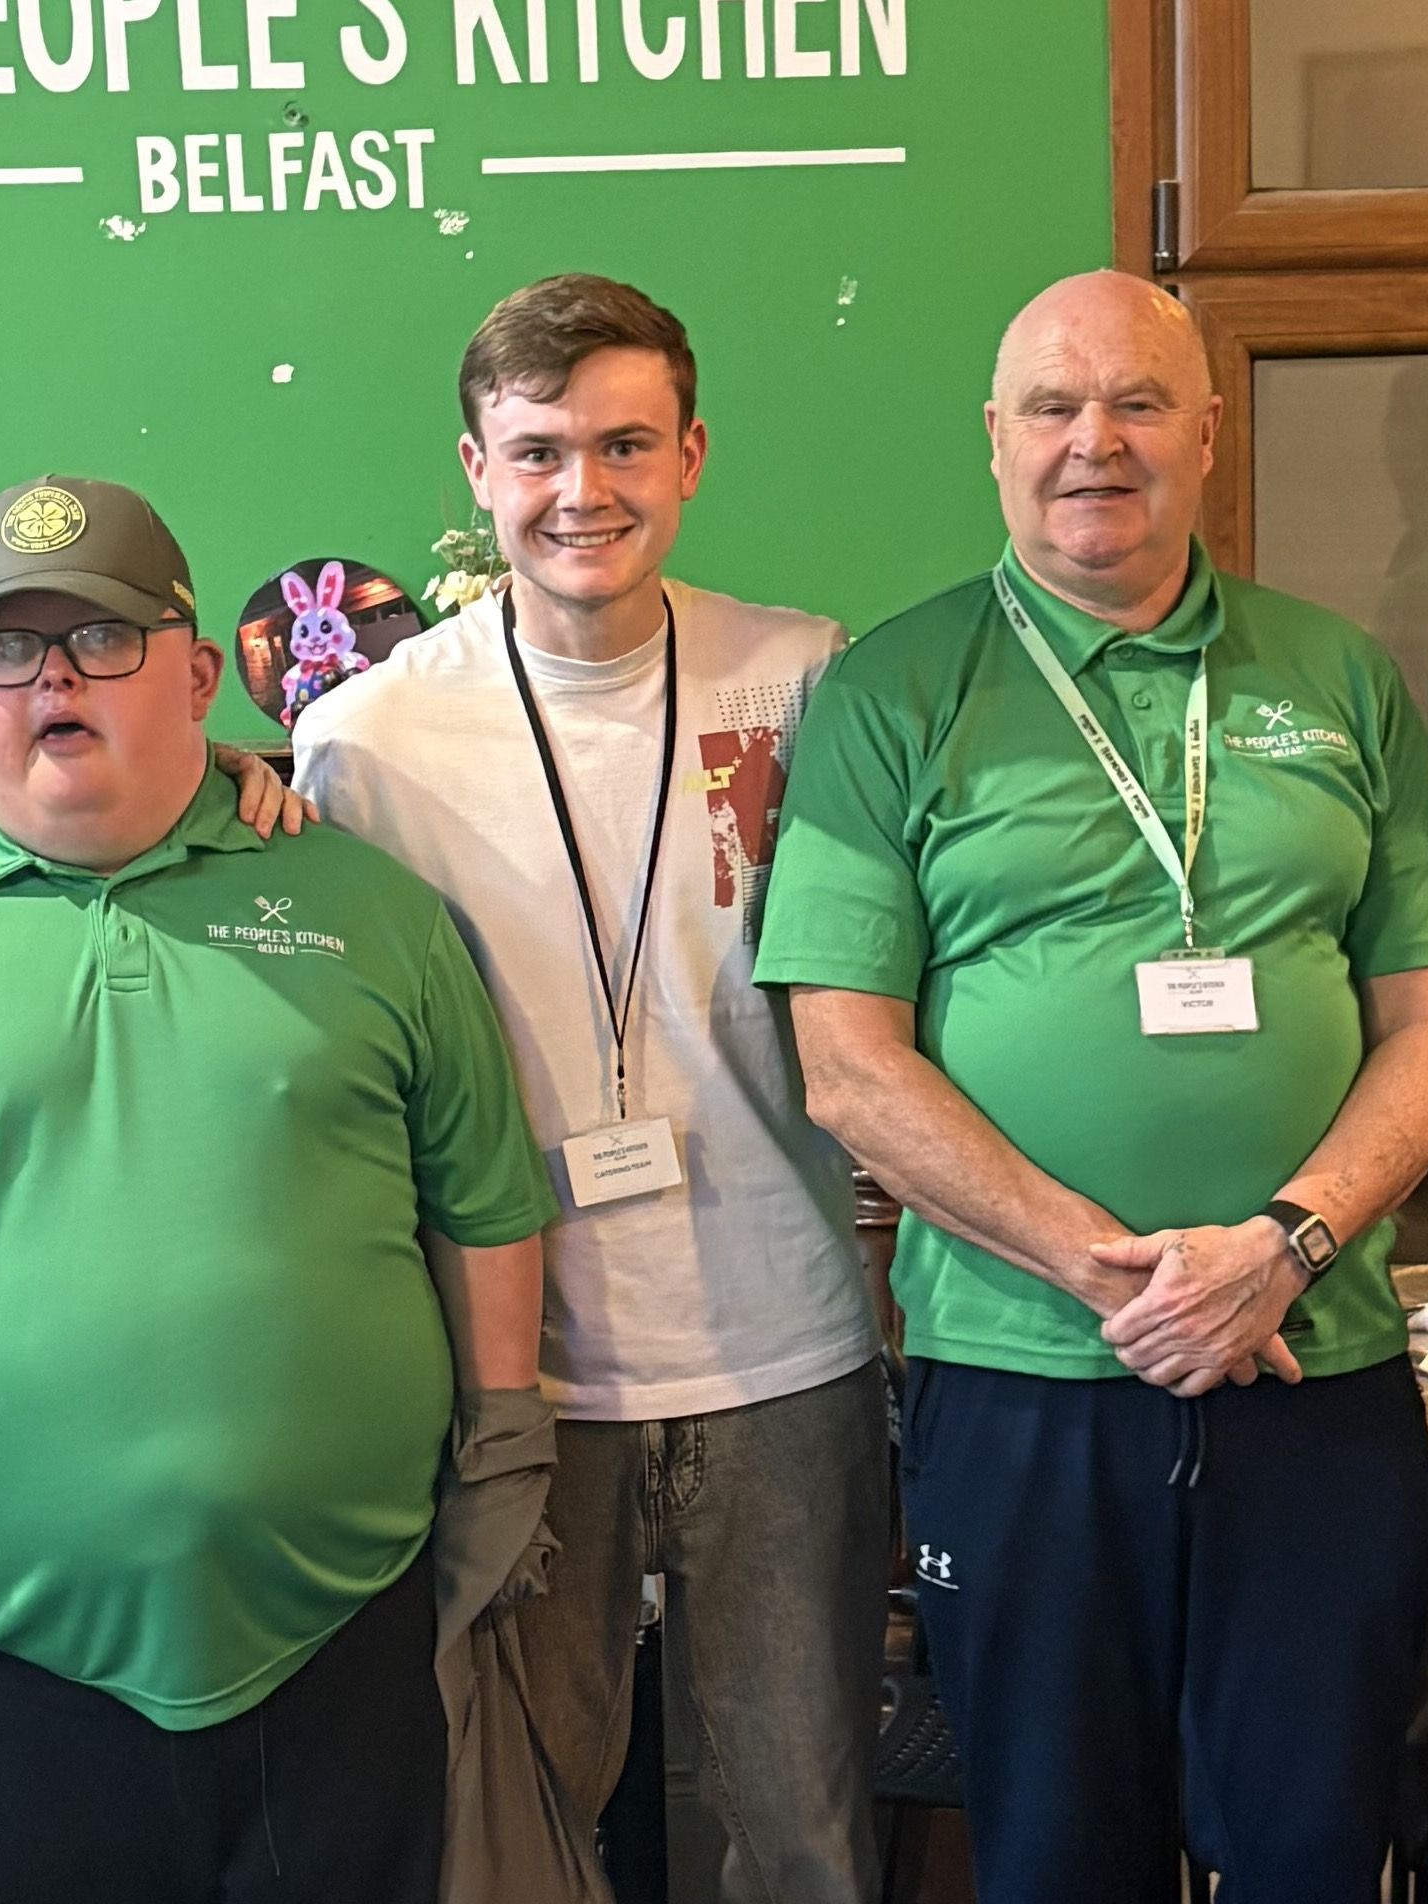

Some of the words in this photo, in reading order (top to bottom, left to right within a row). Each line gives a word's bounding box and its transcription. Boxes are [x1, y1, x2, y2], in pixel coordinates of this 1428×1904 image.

[135, 128, 435, 216] BELFAST
[1224, 734, 1244, 749] THE
[1245, 730, 1300, 750] PEOPLE'S
[207, 924, 229, 939] THE
[235, 926, 291, 944] PEOPLE'S
[296, 931, 345, 953] KITCHEN
